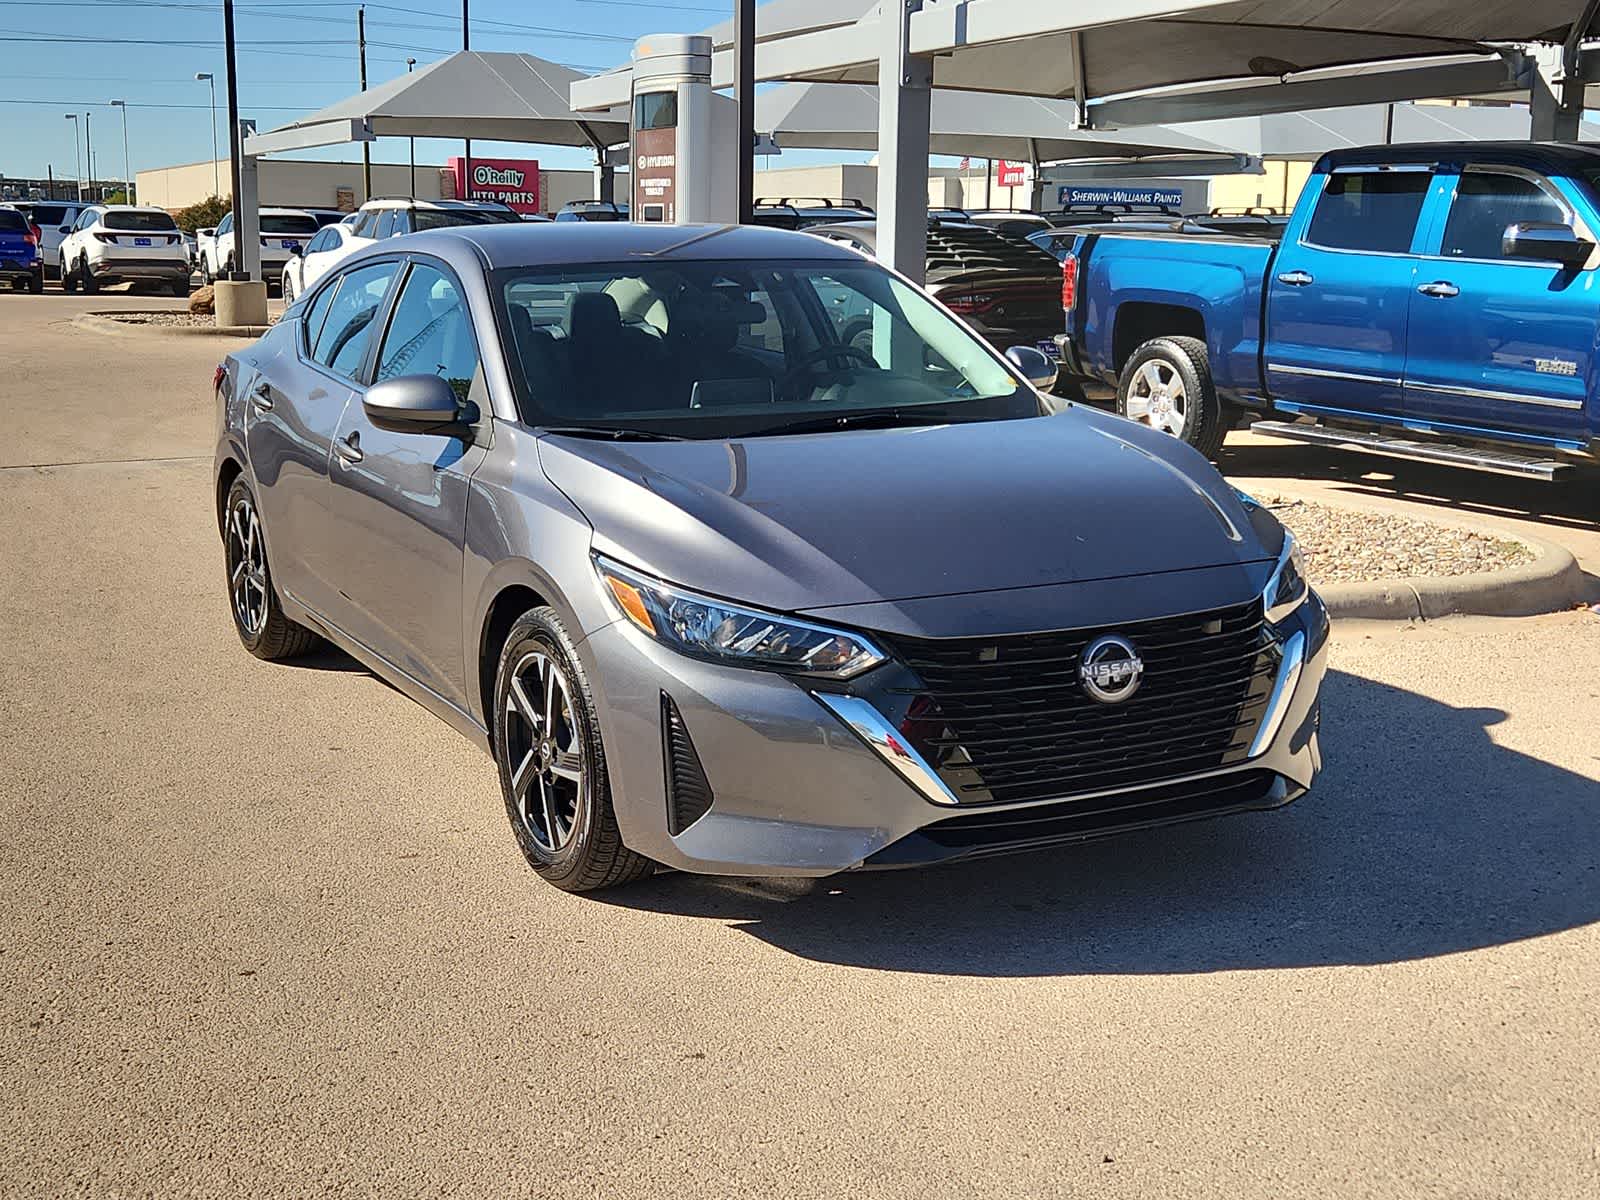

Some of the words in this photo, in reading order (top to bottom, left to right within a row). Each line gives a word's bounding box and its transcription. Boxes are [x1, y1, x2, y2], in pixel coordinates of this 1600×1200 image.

[474, 166, 525, 188] O'Reilly
[472, 191, 496, 201] UTO
[498, 191, 535, 204] PARTS
[1153, 192, 1182, 204] PAINTS
[1081, 658, 1144, 678] NISSAN
